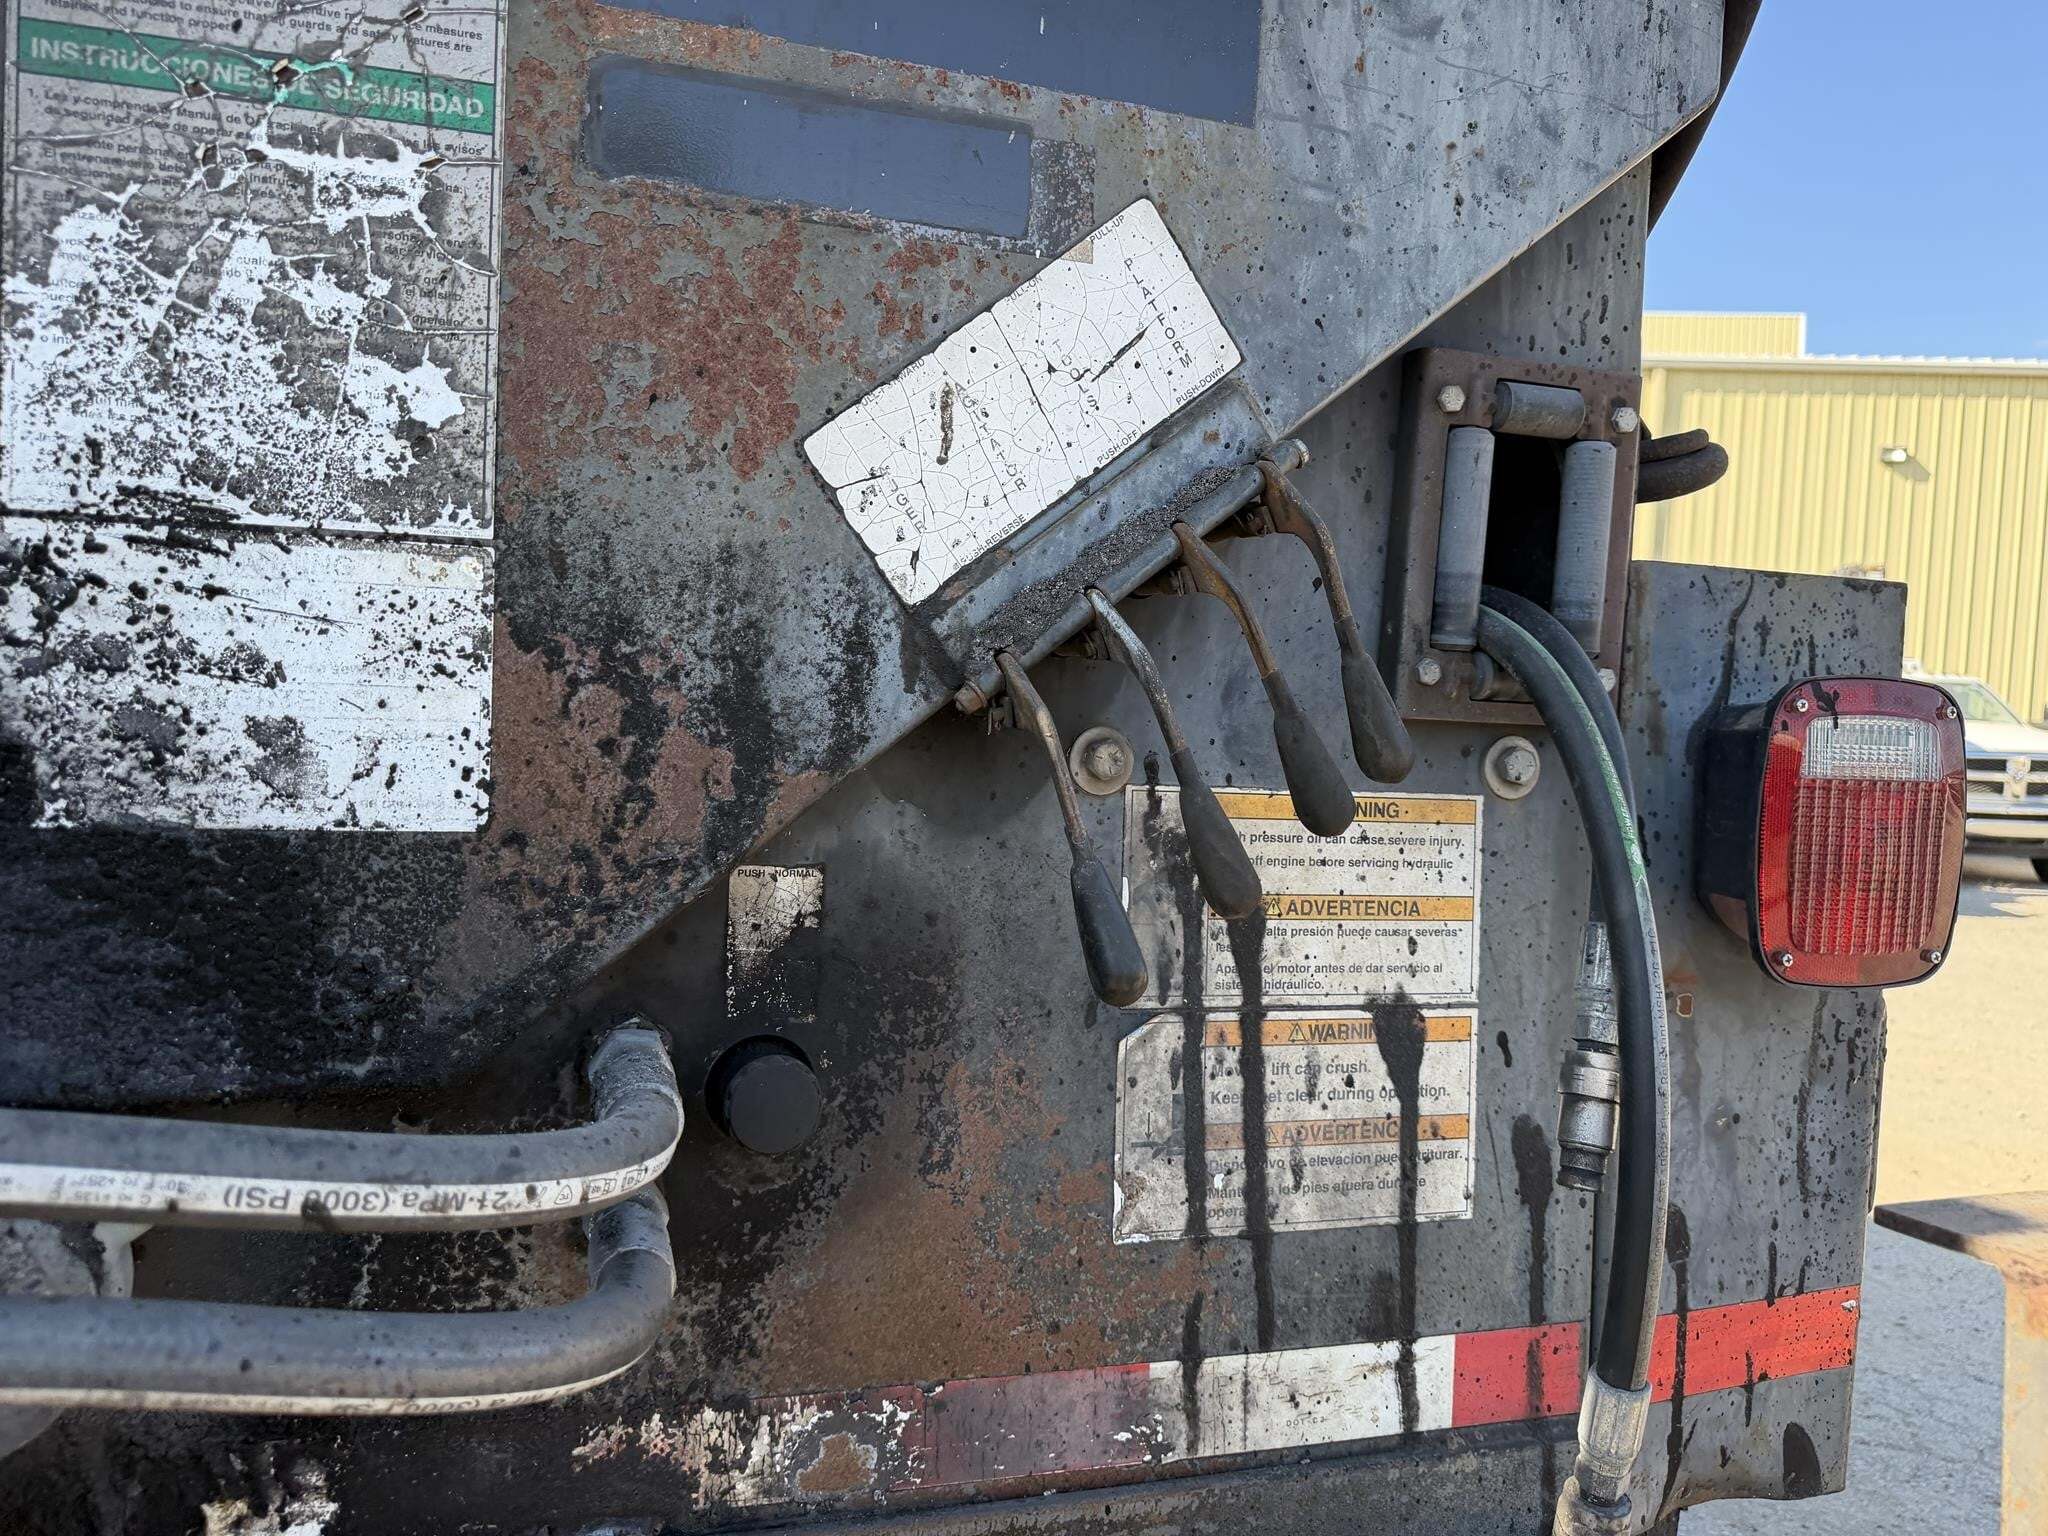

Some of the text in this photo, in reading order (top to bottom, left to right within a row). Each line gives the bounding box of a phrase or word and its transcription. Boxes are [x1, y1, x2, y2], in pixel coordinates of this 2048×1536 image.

[130, 8, 184, 24] function
[195, 3, 239, 18] ensure
[290, 17, 332, 34] guards
[453, 42, 473, 53] are
[425, 22, 483, 41] measures
[326, 79, 484, 118] SEGURIDAD
[226, 114, 241, 125] de
[1089, 214, 1125, 242] PULL-UP
[1124, 257, 1193, 369] PLATFORM
[1176, 364, 1226, 405] PUSH-DOWN
[1097, 429, 1138, 464] PUSH-OFF
[1355, 801, 1400, 819] NING
[1250, 832, 1303, 847] pressure
[1307, 833, 1322, 845] oil
[1325, 834, 1347, 846] can
[1388, 836, 1426, 847] severe
[1429, 835, 1465, 850] injury.
[738, 869, 817, 878] PUSH NORMAL
[1266, 857, 1305, 871] engine
[1348, 857, 1399, 872] servicing
[1402, 858, 1453, 872] hydraulic
[1286, 899, 1421, 918] ADVERTENCIA
[1266, 925, 1457, 942] alta presión puede causar severas
[1263, 963, 1274, 974] el
[1277, 964, 1311, 974] motor
[1314, 964, 1346, 974] antes
[1349, 962, 1363, 974] de
[1365, 962, 1384, 974] dar
[1432, 962, 1443, 974] al
[1264, 977, 1325, 990] hidráulico.
[1309, 1022, 1377, 1043] WARNIN
[1271, 1061, 1291, 1076] lift
[1325, 1060, 1371, 1076] crush.
[1211, 1091, 1240, 1105] Kee
[1286, 1088, 1323, 1103] clear
[1327, 1086, 1375, 1104] during
[1282, 1120, 1398, 1143] ADVERTENC
[1308, 1150, 1371, 1167] elevación
[1302, 1181, 1330, 1195] pies
[1334, 1178, 1374, 1192] afuera
[222, 1185, 292, 1212] PSI)
